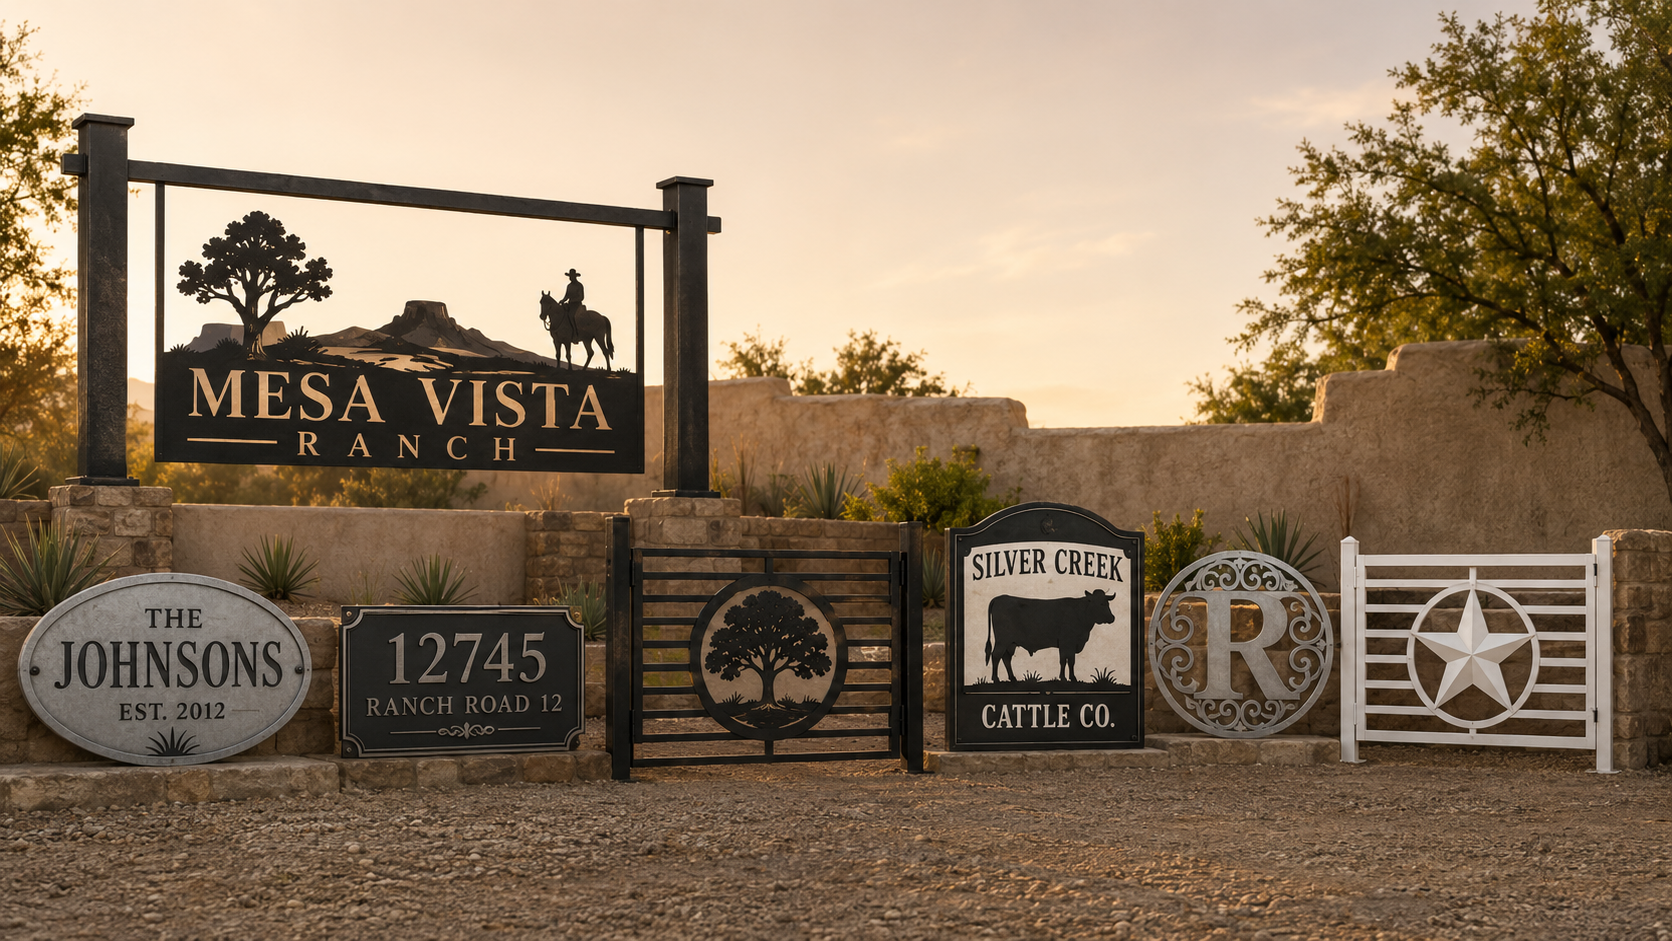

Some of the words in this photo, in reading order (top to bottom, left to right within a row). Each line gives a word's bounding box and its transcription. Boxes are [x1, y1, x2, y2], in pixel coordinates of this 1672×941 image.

[188, 368, 386, 423] MESA
[418, 377, 612, 430] VISTA
[297, 431, 516, 461] RANCH
[972, 549, 1046, 581] SILVER
[1054, 549, 1123, 582] CREEK
[145, 608, 202, 628] THE
[388, 631, 547, 684] 12745
[1194, 590, 1300, 700] R
[54, 640, 283, 689] JOHNSONS
[119, 703, 167, 721] EST.
[177, 702, 225, 720] 2012
[366, 696, 453, 717] RANCH
[464, 695, 530, 714] ROAD
[541, 694, 562, 712] 12
[981, 704, 1070, 729] CATTLE
[1080, 703, 1115, 728] CO.
